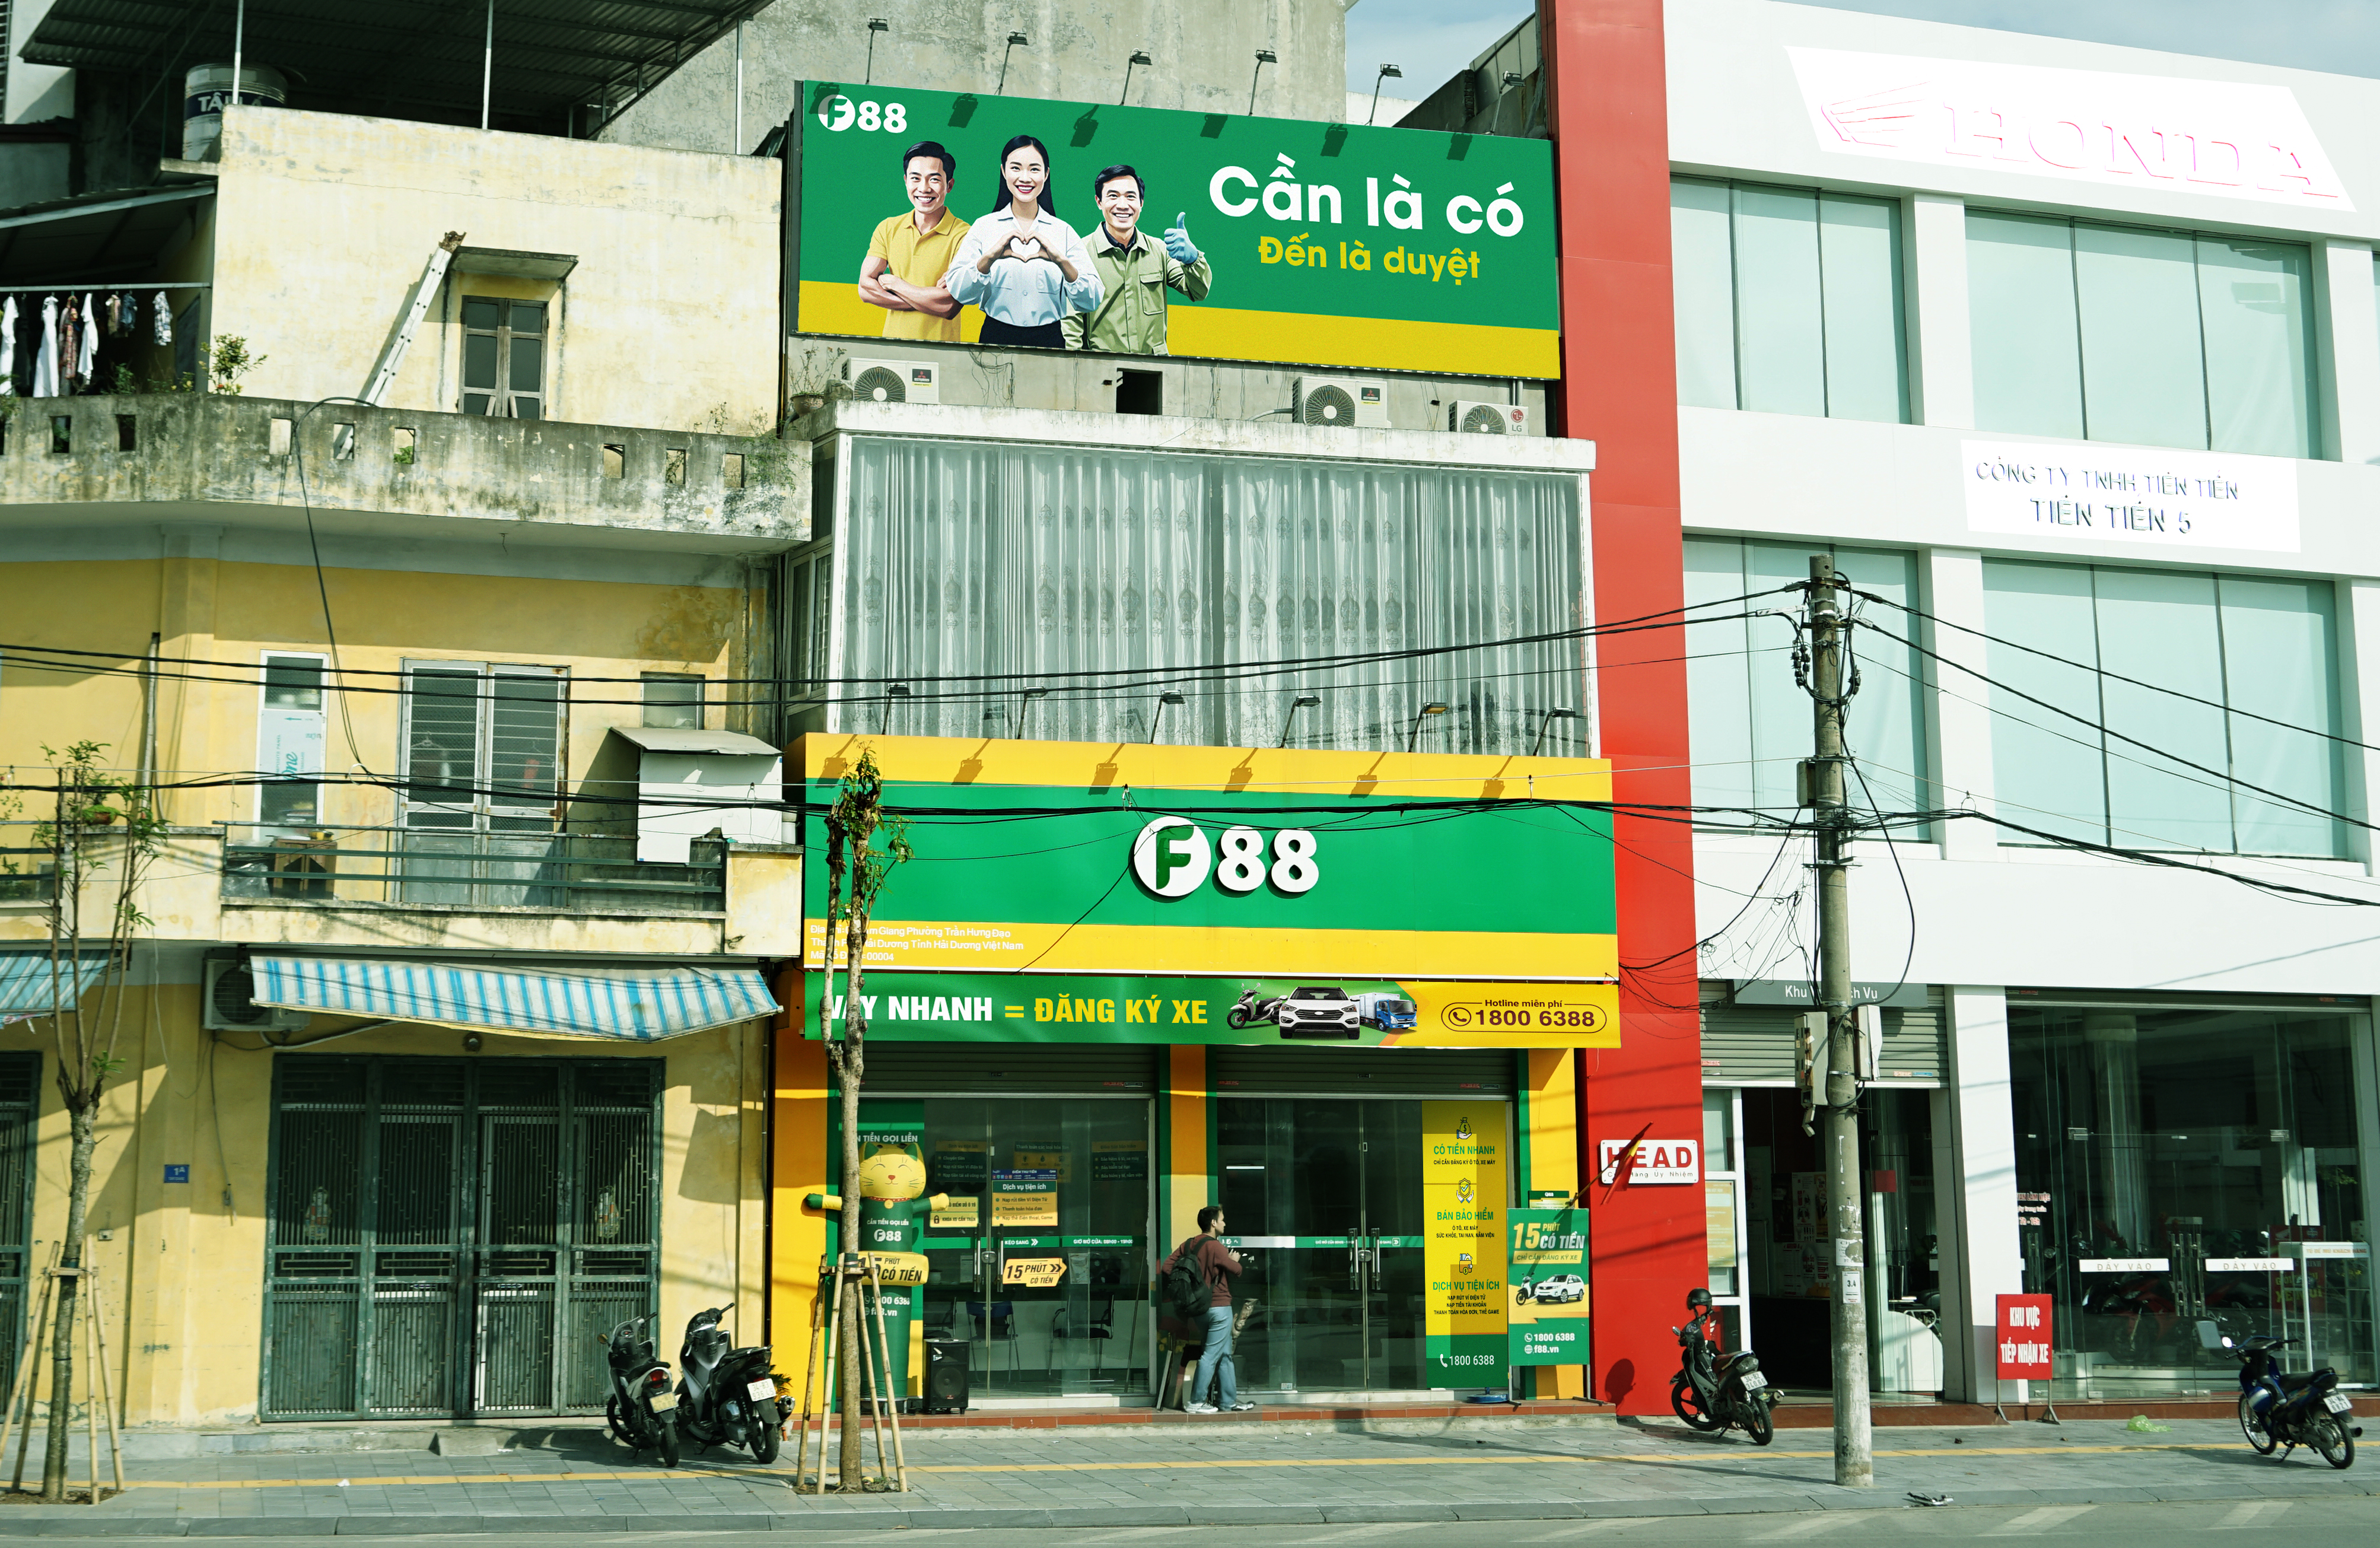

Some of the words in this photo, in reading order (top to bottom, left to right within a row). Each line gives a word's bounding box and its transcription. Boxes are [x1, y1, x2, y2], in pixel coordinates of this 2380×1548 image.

[817, 94, 908, 133] F88
[1942, 100, 2339, 198] HONDA
[1209, 152, 1342, 224] Cần
[1366, 173, 1423, 230] là
[1446, 181, 1524, 237] có
[1258, 232, 1327, 268] Đến
[1339, 239, 1371, 271] là
[1383, 246, 1481, 286] duyệt
[2045, 465, 2072, 487] TY
[2081, 469, 2136, 492] TNHH
[2178, 511, 2191, 534] 5
[1134, 816, 1319, 897] F88
[879, 927, 905, 937] Giang
[906, 926, 943, 937] Phường
[944, 925, 966, 936] Trần
[967, 927, 991, 938] Hưng
[992, 929, 1011, 939] Đạo
[877, 939, 909, 950] Dương
[911, 939, 932, 948] Tỉnh
[934, 939, 949, 949] Hải
[950, 940, 981, 951] Dương
[982, 941, 1001, 951] Việt
[1003, 942, 1024, 950] Nam
[1785, 985, 1807, 998] Khu
[1863, 987, 1878, 1002] Vụ
[831, 995, 878, 1020] VY
[889, 996, 992, 1021] NHANH
[1034, 993, 1115, 1023] ĐĂNG
[1125, 994, 1162, 1023] KÝ
[1172, 1000, 1208, 1024] XE
[1522, 999, 1545, 1007] miễn
[1548, 1000, 1563, 1009] phí
[1475, 1009, 1531, 1026] 1800
[1539, 1010, 1595, 1027] 6388
[882, 1135, 899, 1144] GỌI
[1433, 1143, 1445, 1155] CÓ
[1447, 1142, 1465, 1155] TIỀN
[1467, 1146, 1495, 1155] NHANH
[1607, 1147, 1692, 1168] HEAD
[1437, 1209, 1453, 1220] BÁN
[1456, 1208, 1472, 1220] BẢO
[1474, 1207, 1494, 1220] HIỂM
[874, 1229, 902, 1242] F88
[1513, 1223, 1541, 1249] 15
[1542, 1222, 1560, 1232] PHÚT
[1539, 1232, 1556, 1249] CÓ
[1560, 1231, 1585, 1249] TIỀN
[881, 1266, 896, 1280] CÓ
[1007, 1265, 1024, 1279] 15
[1024, 1262, 1048, 1273] PHÚT
[1030, 1275, 1039, 1284] CÓ
[1040, 1275, 1054, 1284] TIỀN
[1433, 1281, 1452, 1292] DỊCH
[1453, 1281, 1464, 1292] VỤ
[1466, 1279, 1484, 1292] TIỆN
[1486, 1279, 1500, 1290] ÍCH
[871, 1307, 898, 1316] f8.vn
[2009, 1307, 2025, 1327] KHU
[2025, 1305, 2040, 1330] VỰC
[1533, 1333, 1553, 1342] 1800
[1555, 1333, 1575, 1341] 6388
[1534, 1344, 1559, 1353] f88.vn
[2000, 1336, 2017, 1363] TIẾP
[2018, 1340, 2038, 1366] NHẬN
[2038, 1343, 2049, 1363] XE
[1449, 1355, 1471, 1366] 1800
[1473, 1355, 1494, 1365] 6388
